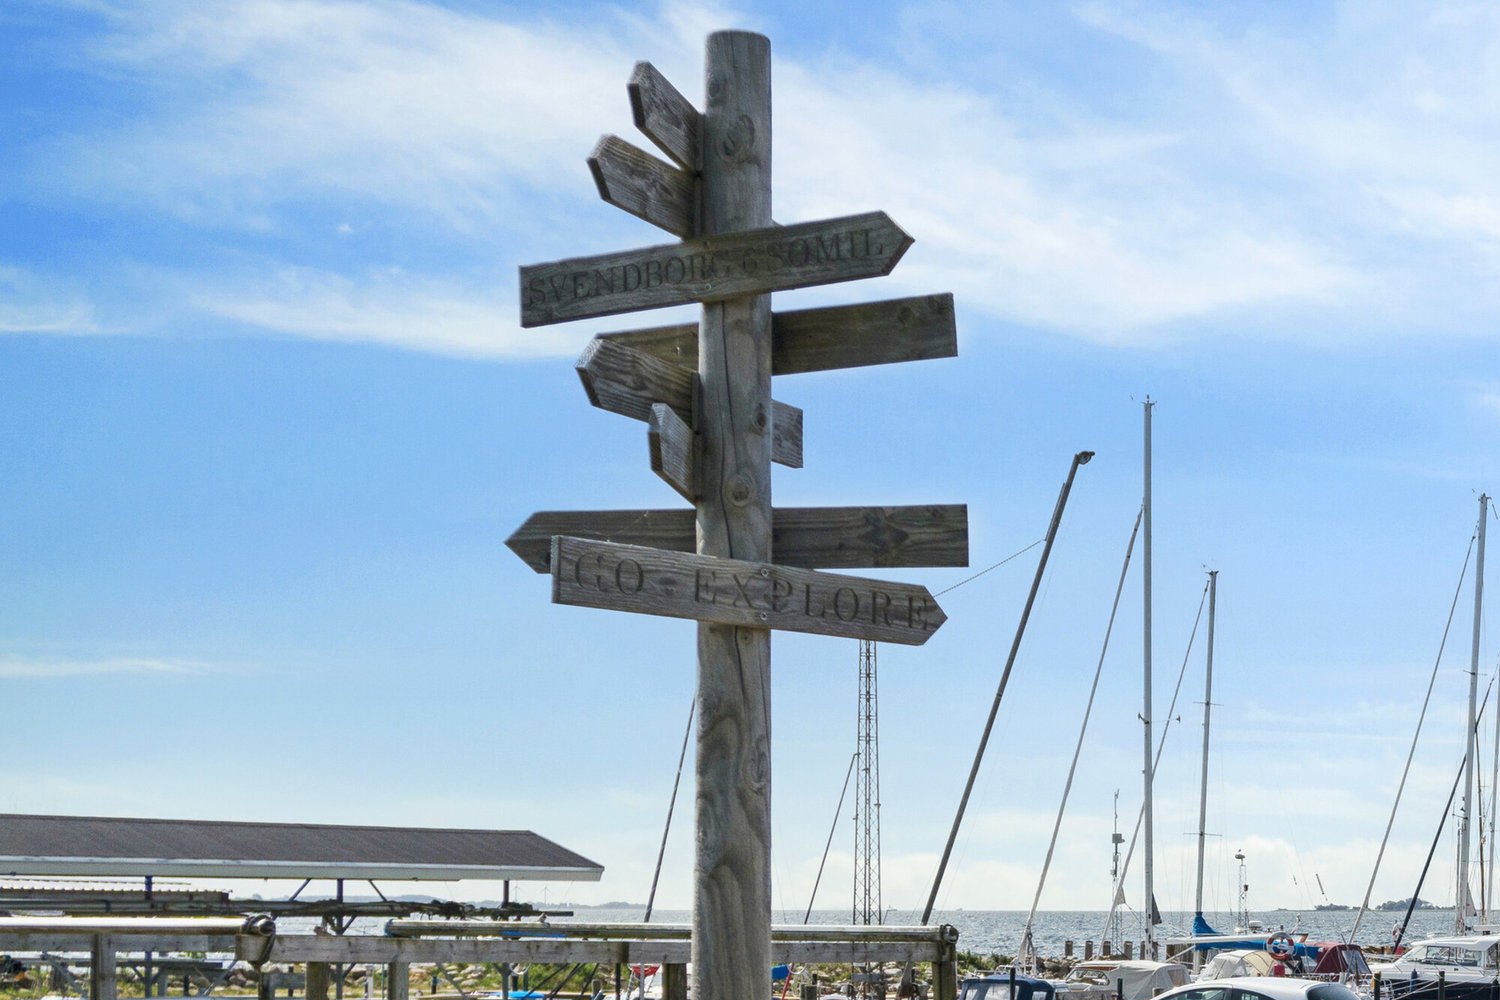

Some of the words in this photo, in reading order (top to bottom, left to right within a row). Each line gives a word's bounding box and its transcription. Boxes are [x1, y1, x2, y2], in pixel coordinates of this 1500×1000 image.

[528, 251, 731, 305] SVENDBORG
[573, 553, 645, 596] GO
[694, 567, 930, 631] EXPLORE
